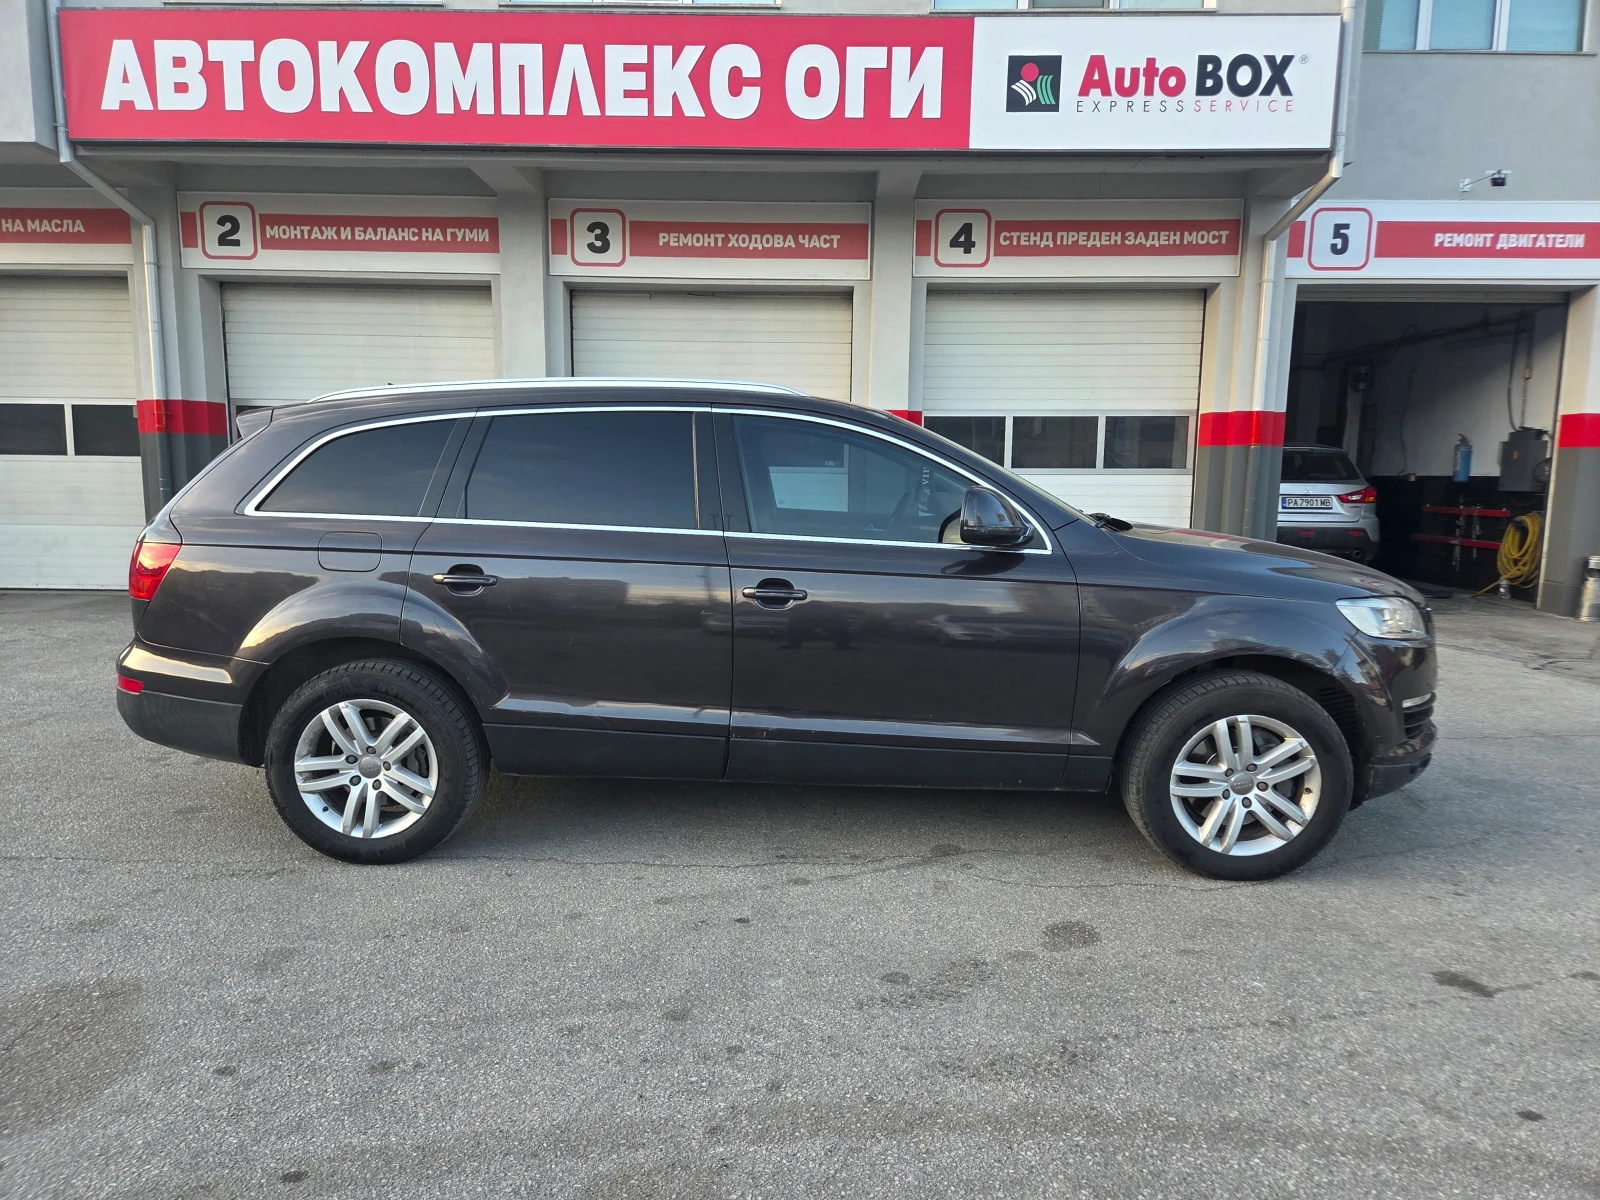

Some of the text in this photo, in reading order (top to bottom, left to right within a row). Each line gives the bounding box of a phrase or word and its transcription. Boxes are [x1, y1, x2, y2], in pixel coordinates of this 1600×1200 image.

[100, 38, 944, 121] АВТОКОМПЛЕКС ОГИ
[1077, 53, 1296, 97] Auto BOX
[1, 218, 86, 233] НА МАСЛА
[216, 214, 241, 247] 2
[265, 225, 490, 243] МОНТАЖ И БАЛАНС НА ГУМИ
[586, 221, 611, 254] 3
[658, 232, 840, 251] РЕМОНТ ХОДОВА ЧАСТ
[949, 222, 976, 255] 4
[999, 230, 1230, 248] СТЕНД ПРЕДЕН ЗАДЕН МОСТ
[1329, 223, 1351, 256] 5
[1434, 233, 1586, 250] РЕМОНТ ДВИГАТЕЛИ
